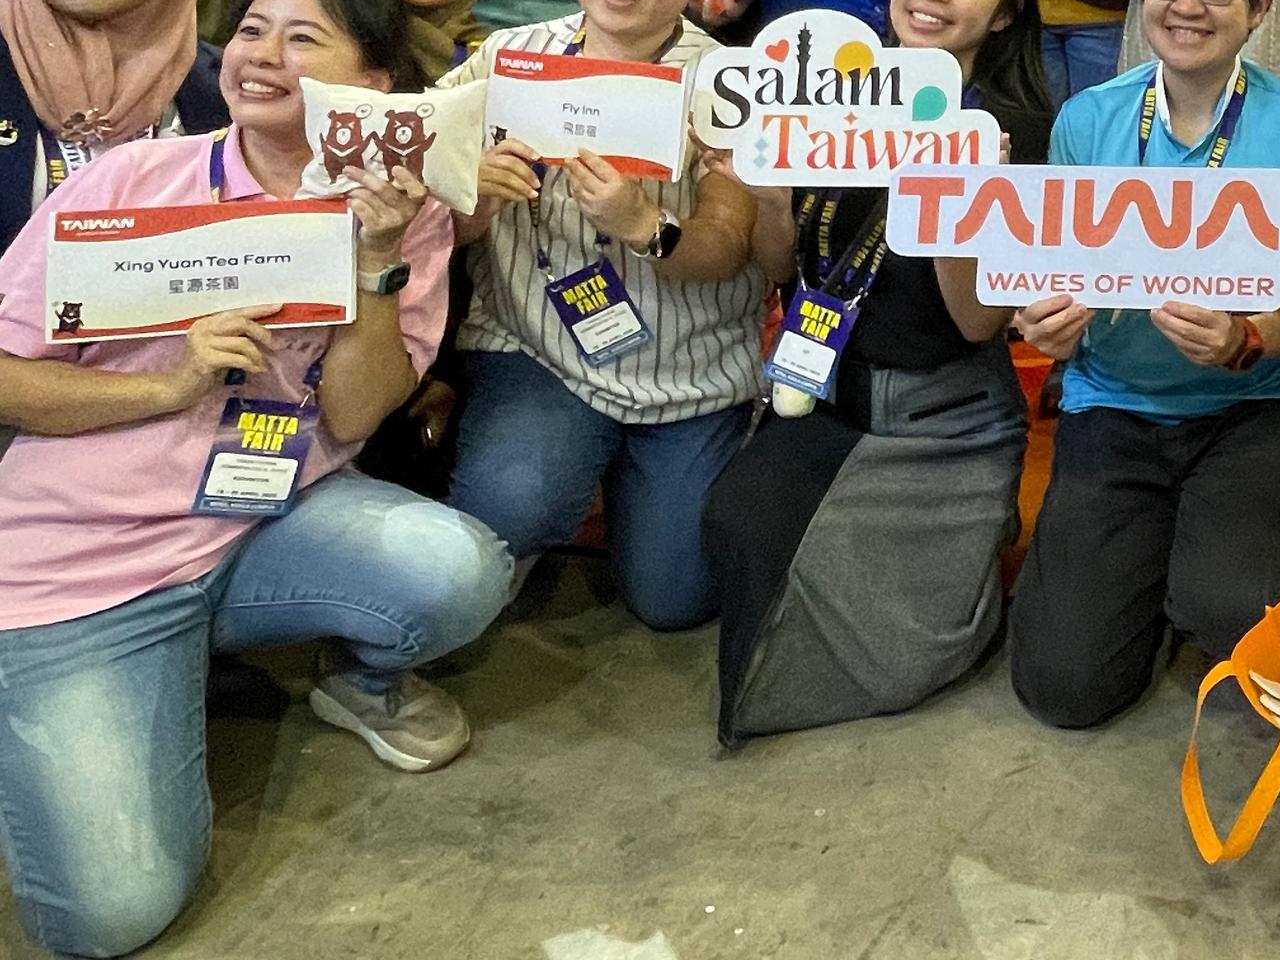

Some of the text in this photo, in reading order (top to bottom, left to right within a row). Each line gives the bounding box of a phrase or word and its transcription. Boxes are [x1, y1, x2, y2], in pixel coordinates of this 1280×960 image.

[711, 22, 904, 129] Salam
[562, 103, 600, 117] Fly Inn
[761, 112, 980, 169] Taiwan
[61, 218, 135, 231] TAIWAN
[113, 253, 291, 273] Xing Yuan Tea Farm
[562, 274, 608, 305] MATTA
[988, 272, 1275, 297] WAVES OF WONDER
[576, 291, 608, 315] FAIR
[800, 300, 842, 329] MATTA
[800, 317, 831, 343] FAIR
[237, 411, 299, 436] MATTA
[241, 430, 285, 452] FAIR
